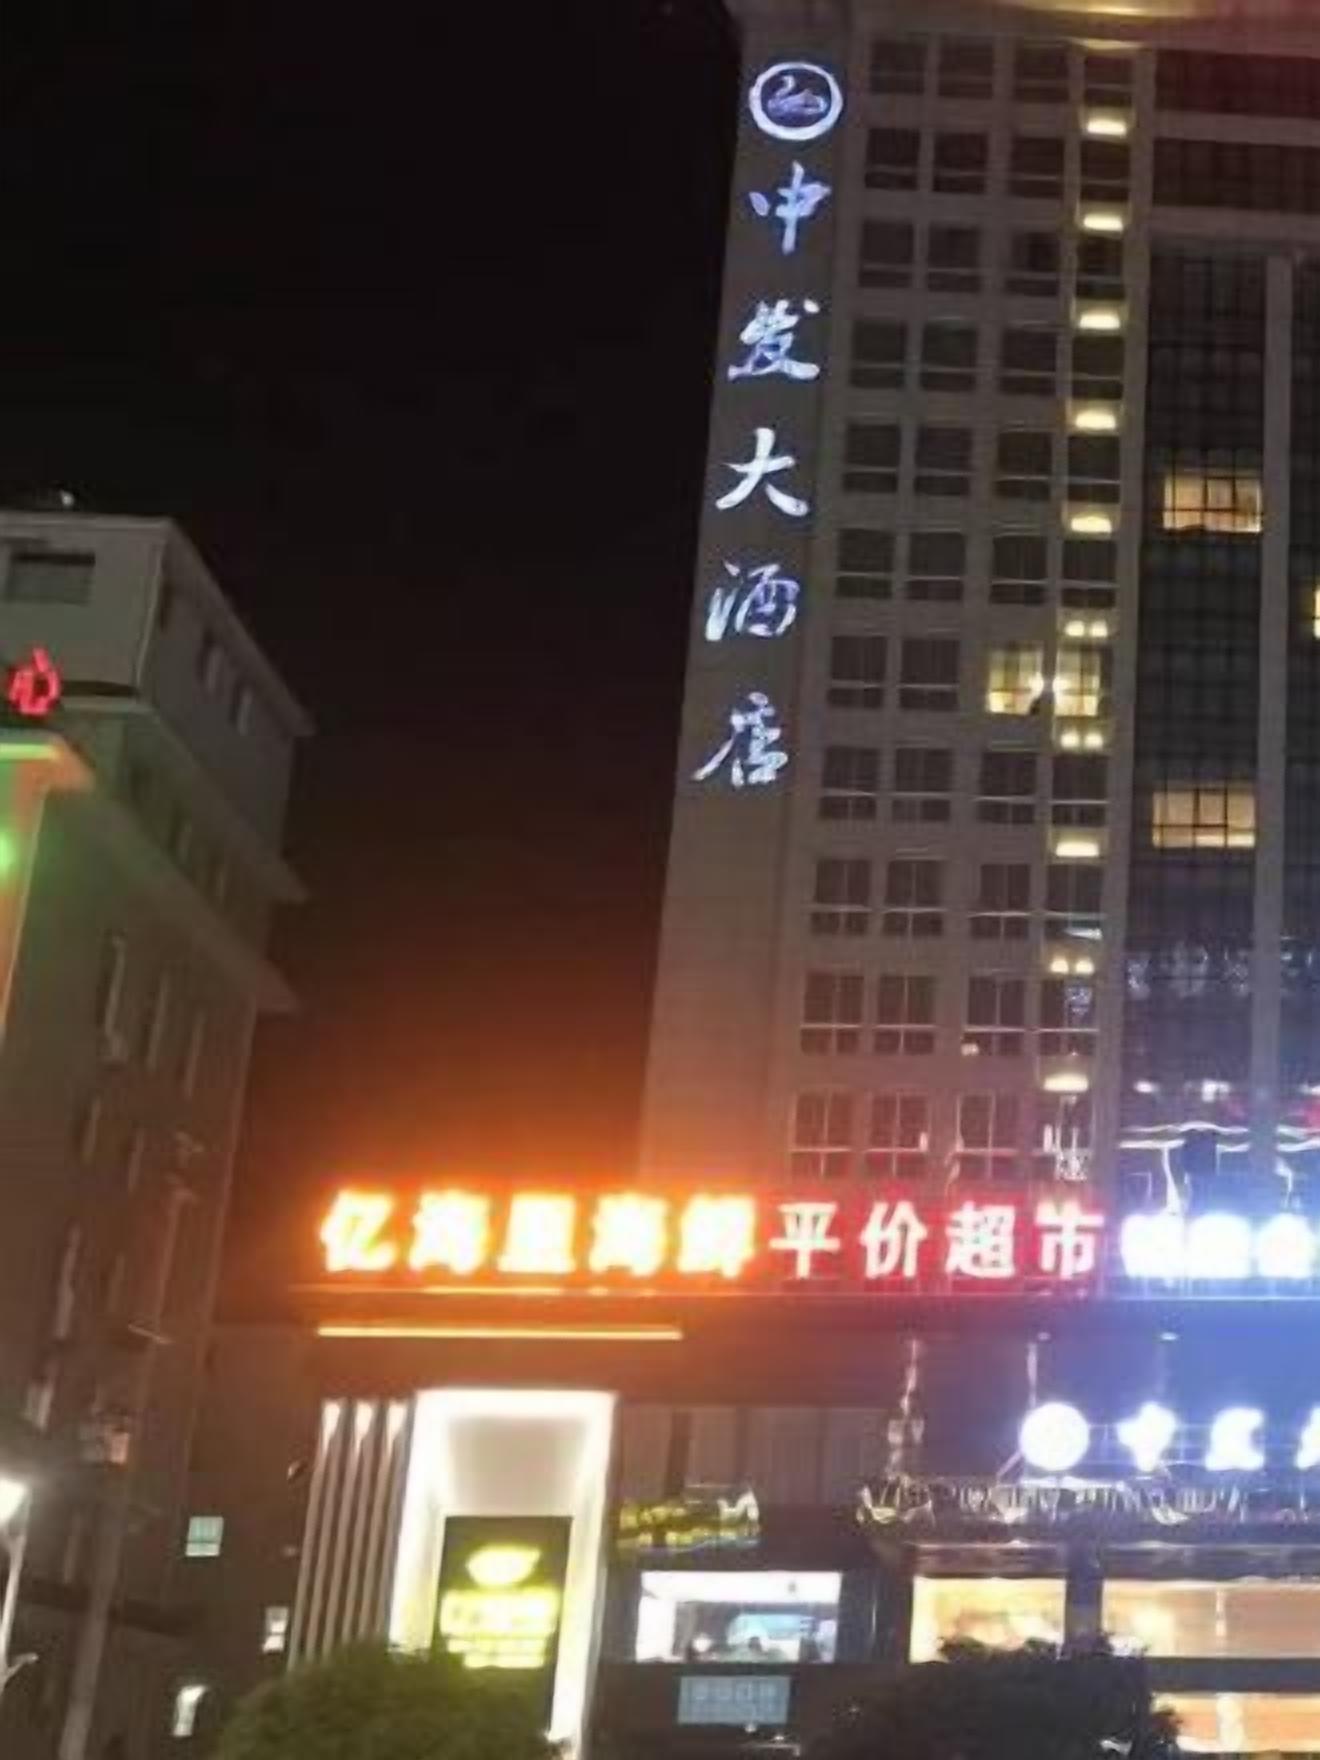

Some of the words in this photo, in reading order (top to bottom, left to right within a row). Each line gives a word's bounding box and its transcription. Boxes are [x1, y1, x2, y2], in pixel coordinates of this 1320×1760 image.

[694, 160, 832, 788] 中发大酒店
